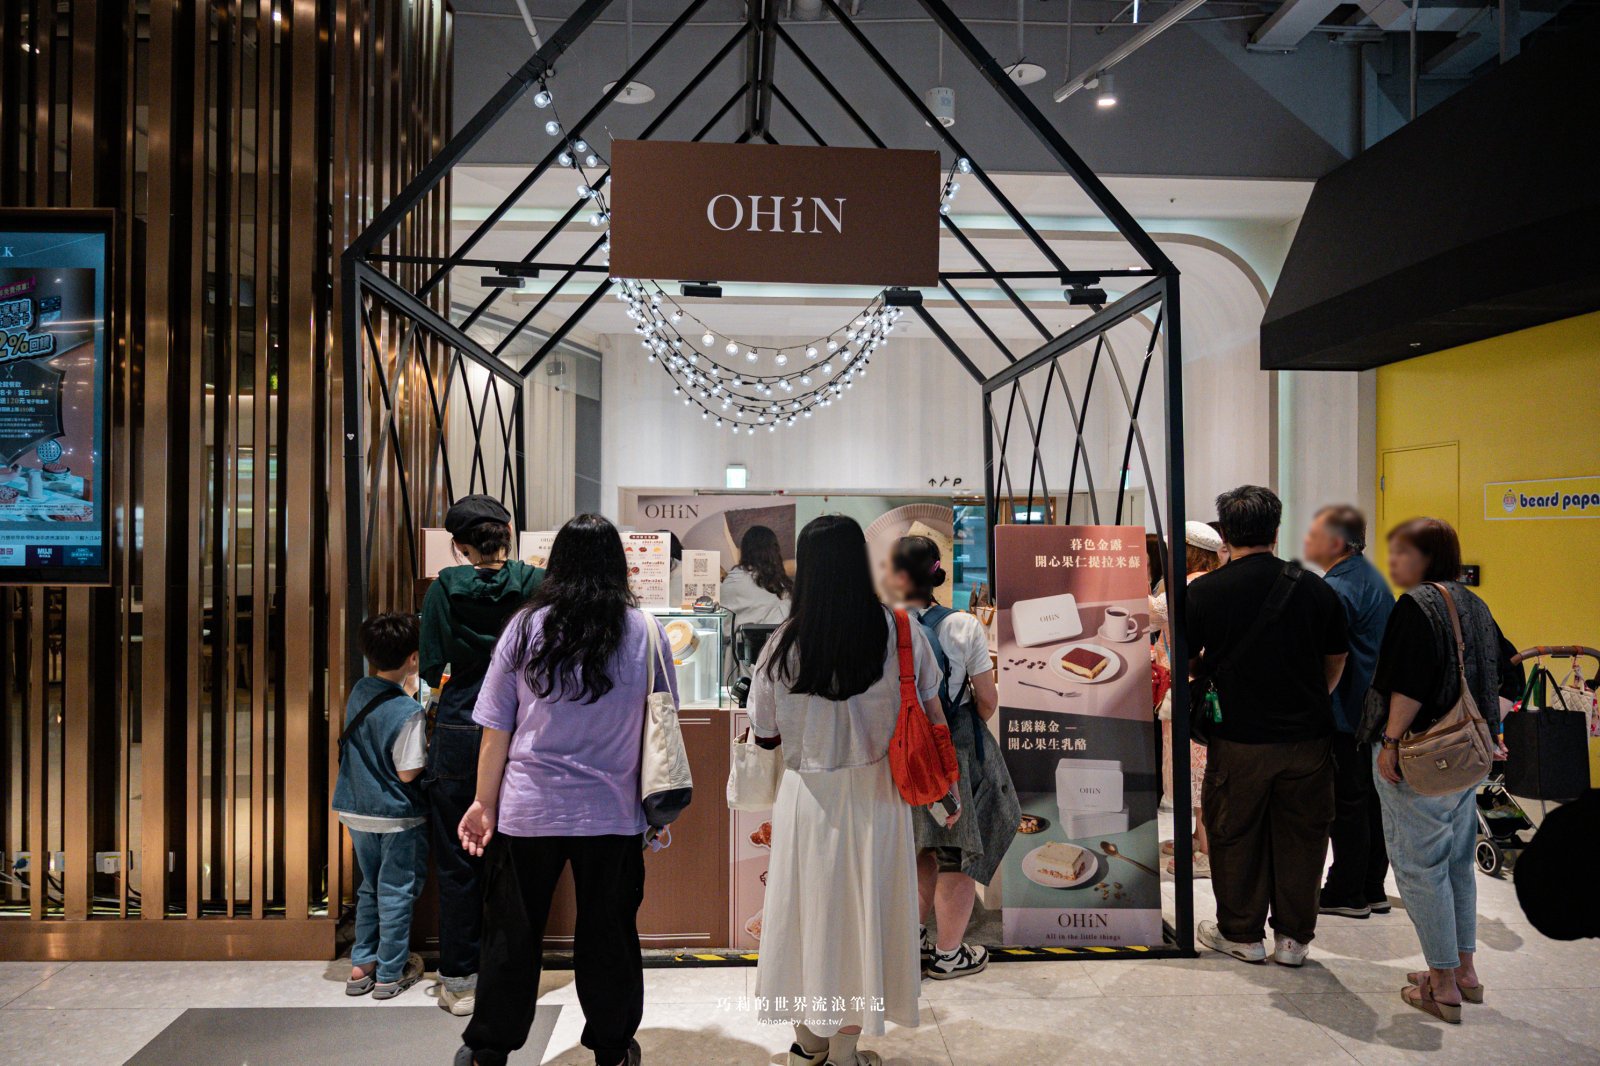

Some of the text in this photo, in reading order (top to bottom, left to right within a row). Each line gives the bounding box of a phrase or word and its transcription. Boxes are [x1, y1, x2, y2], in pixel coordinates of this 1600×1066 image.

[1520, 491, 1559, 508] beard
[1035, 555, 1141, 569] 開心果仁提拉米蘇
[1007, 737, 1087, 751] 開心果生乳酪
[1100, 933, 1121, 942] things
